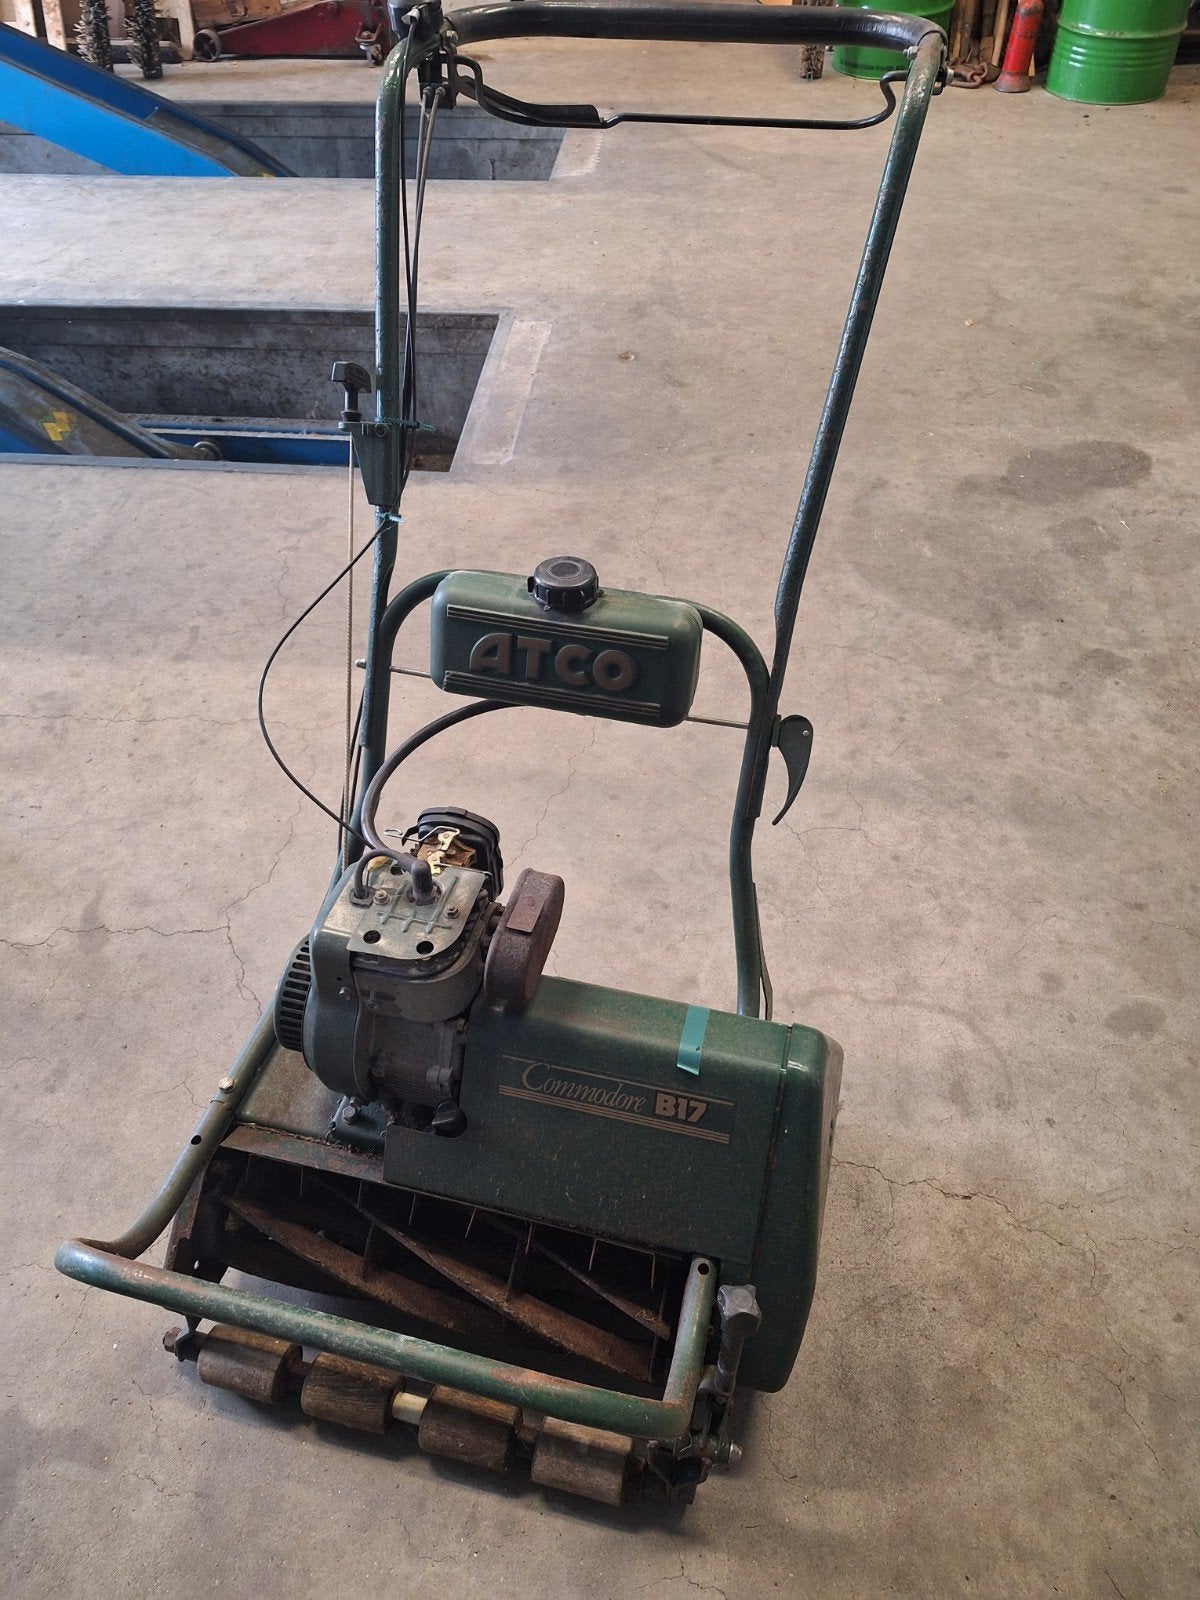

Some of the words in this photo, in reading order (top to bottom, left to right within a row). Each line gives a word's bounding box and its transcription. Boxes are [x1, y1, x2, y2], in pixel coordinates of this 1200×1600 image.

[469, 632, 634, 692] ATCO
[522, 1062, 647, 1112] Commodore
[655, 1093, 706, 1123] B17
